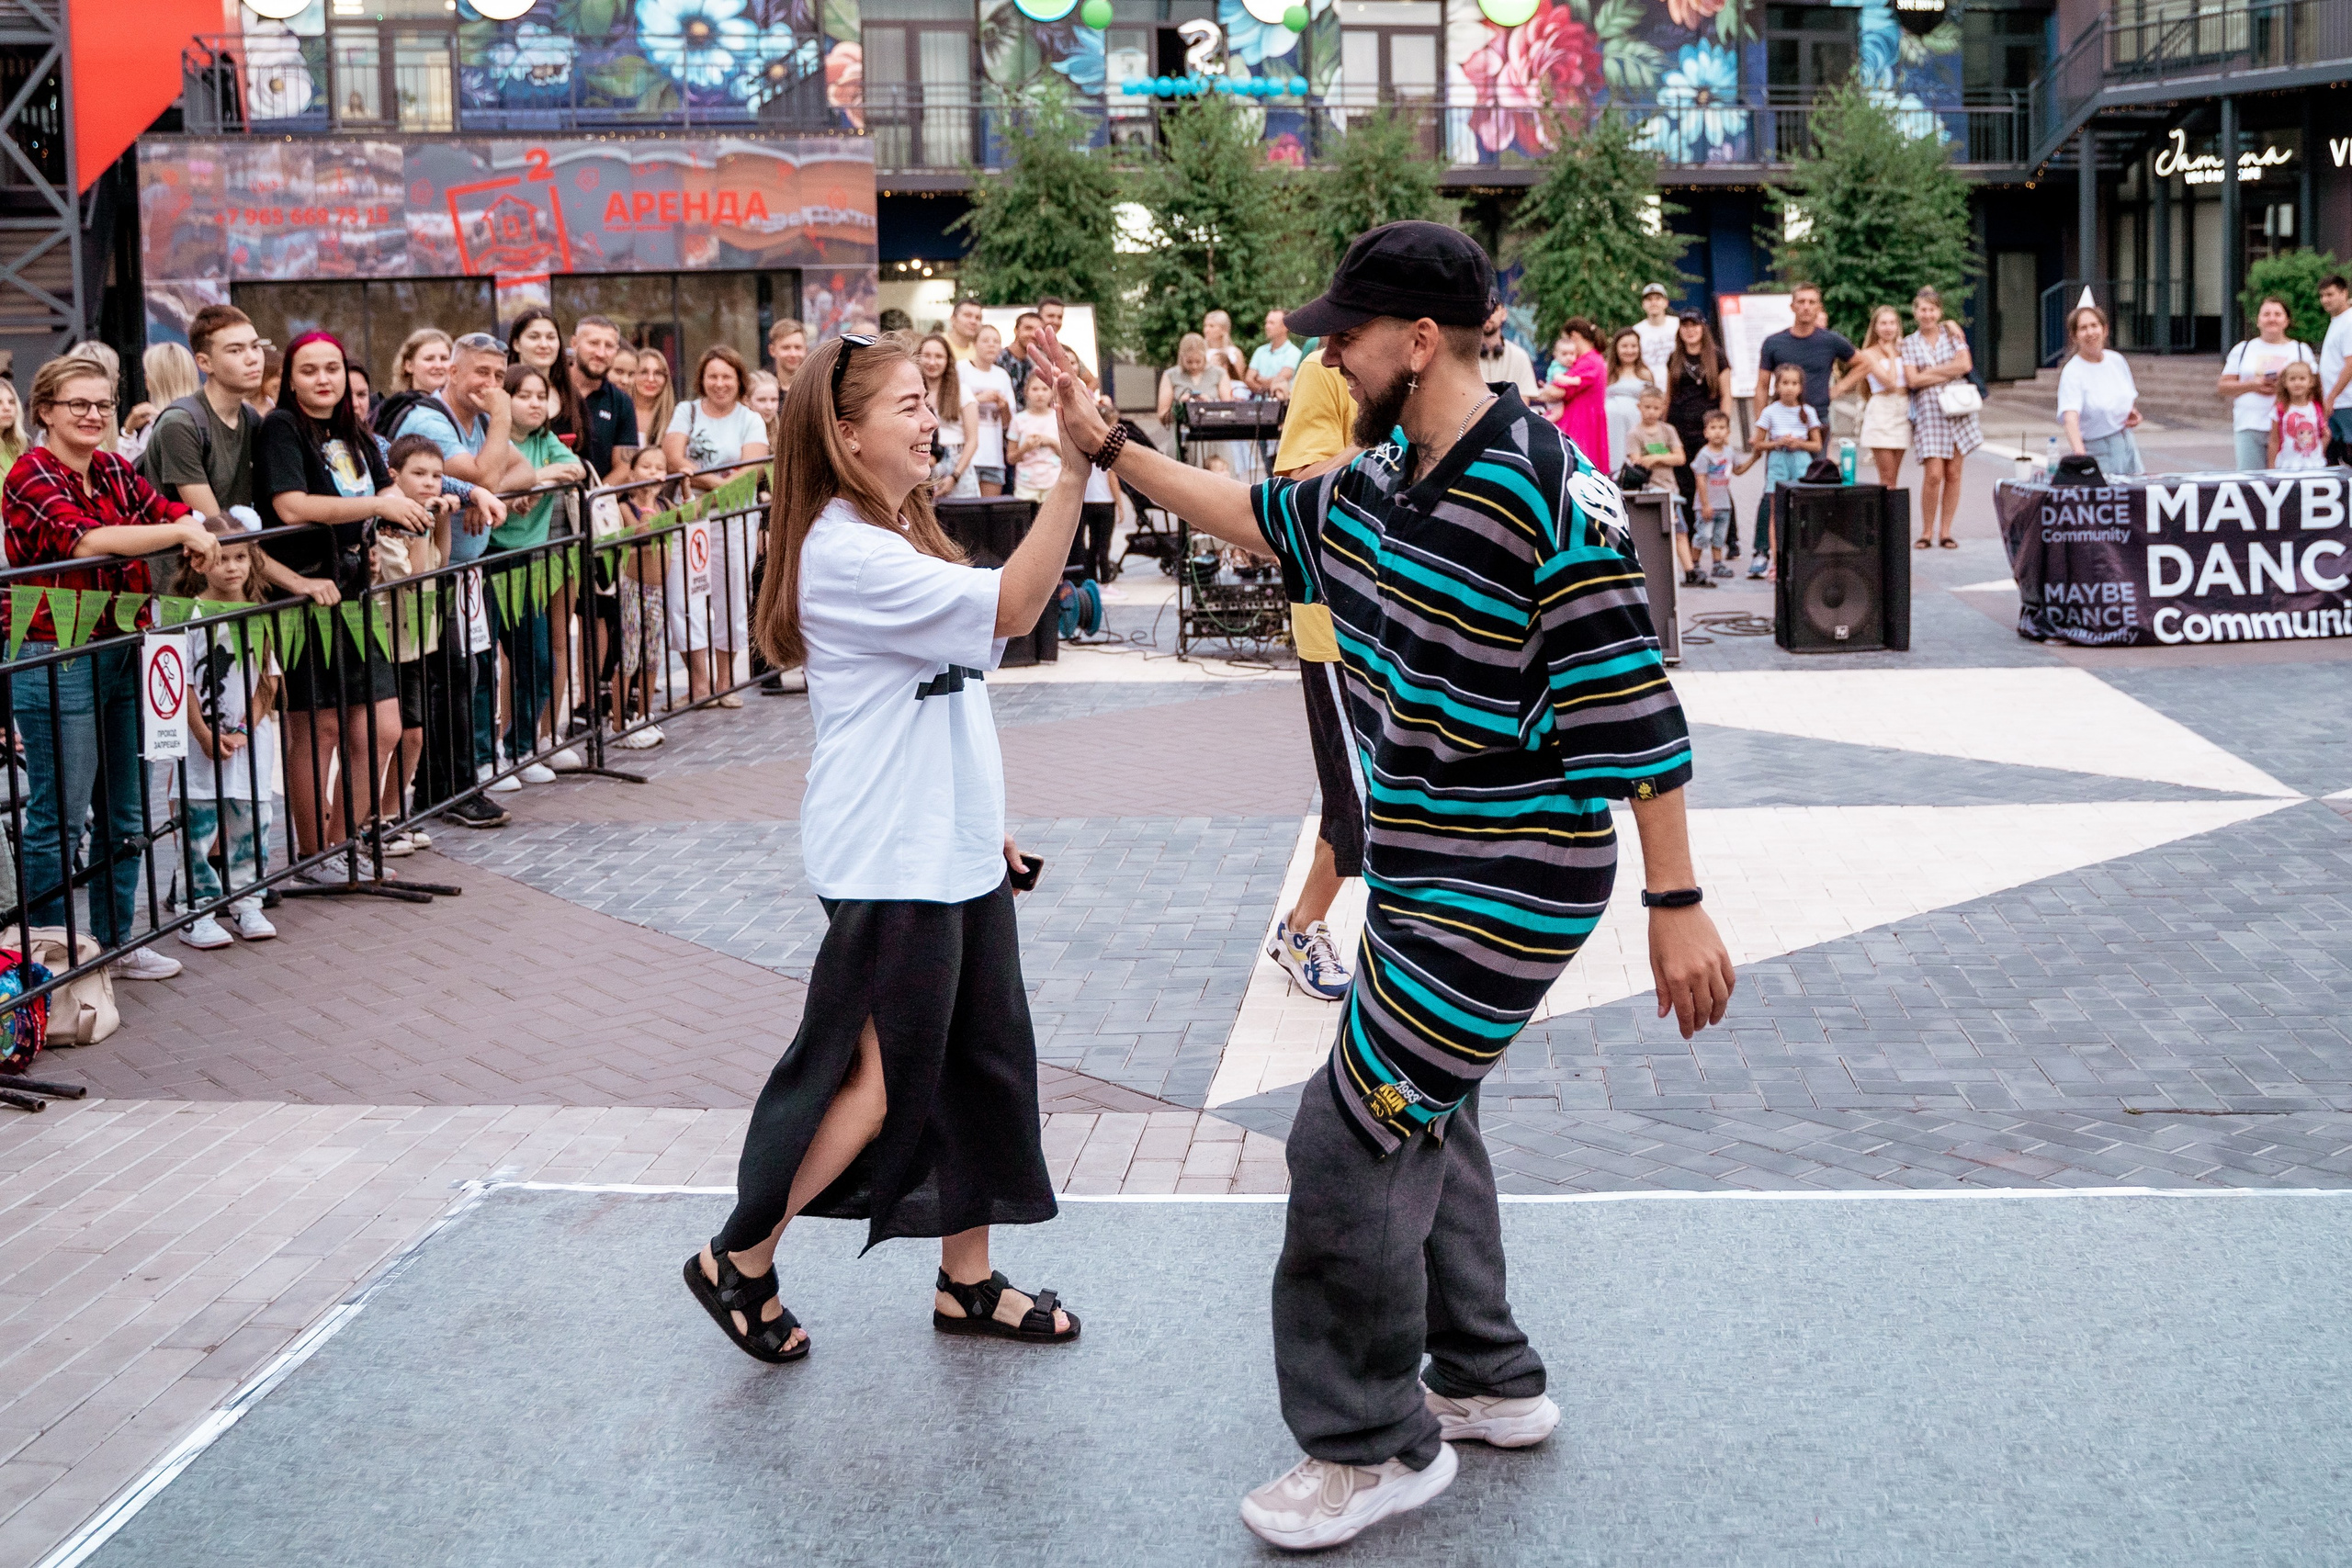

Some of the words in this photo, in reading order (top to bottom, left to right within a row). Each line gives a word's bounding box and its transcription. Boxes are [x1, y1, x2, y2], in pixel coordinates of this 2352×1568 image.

[603, 190, 770, 227] АРЕНДА
[2041, 504, 2132, 526] DANCE
[2041, 526, 2132, 544] Community
[2146, 539, 2351, 598] DANC
[2043, 581, 2137, 604] MAYBE
[2045, 605, 2140, 626] DANCE
